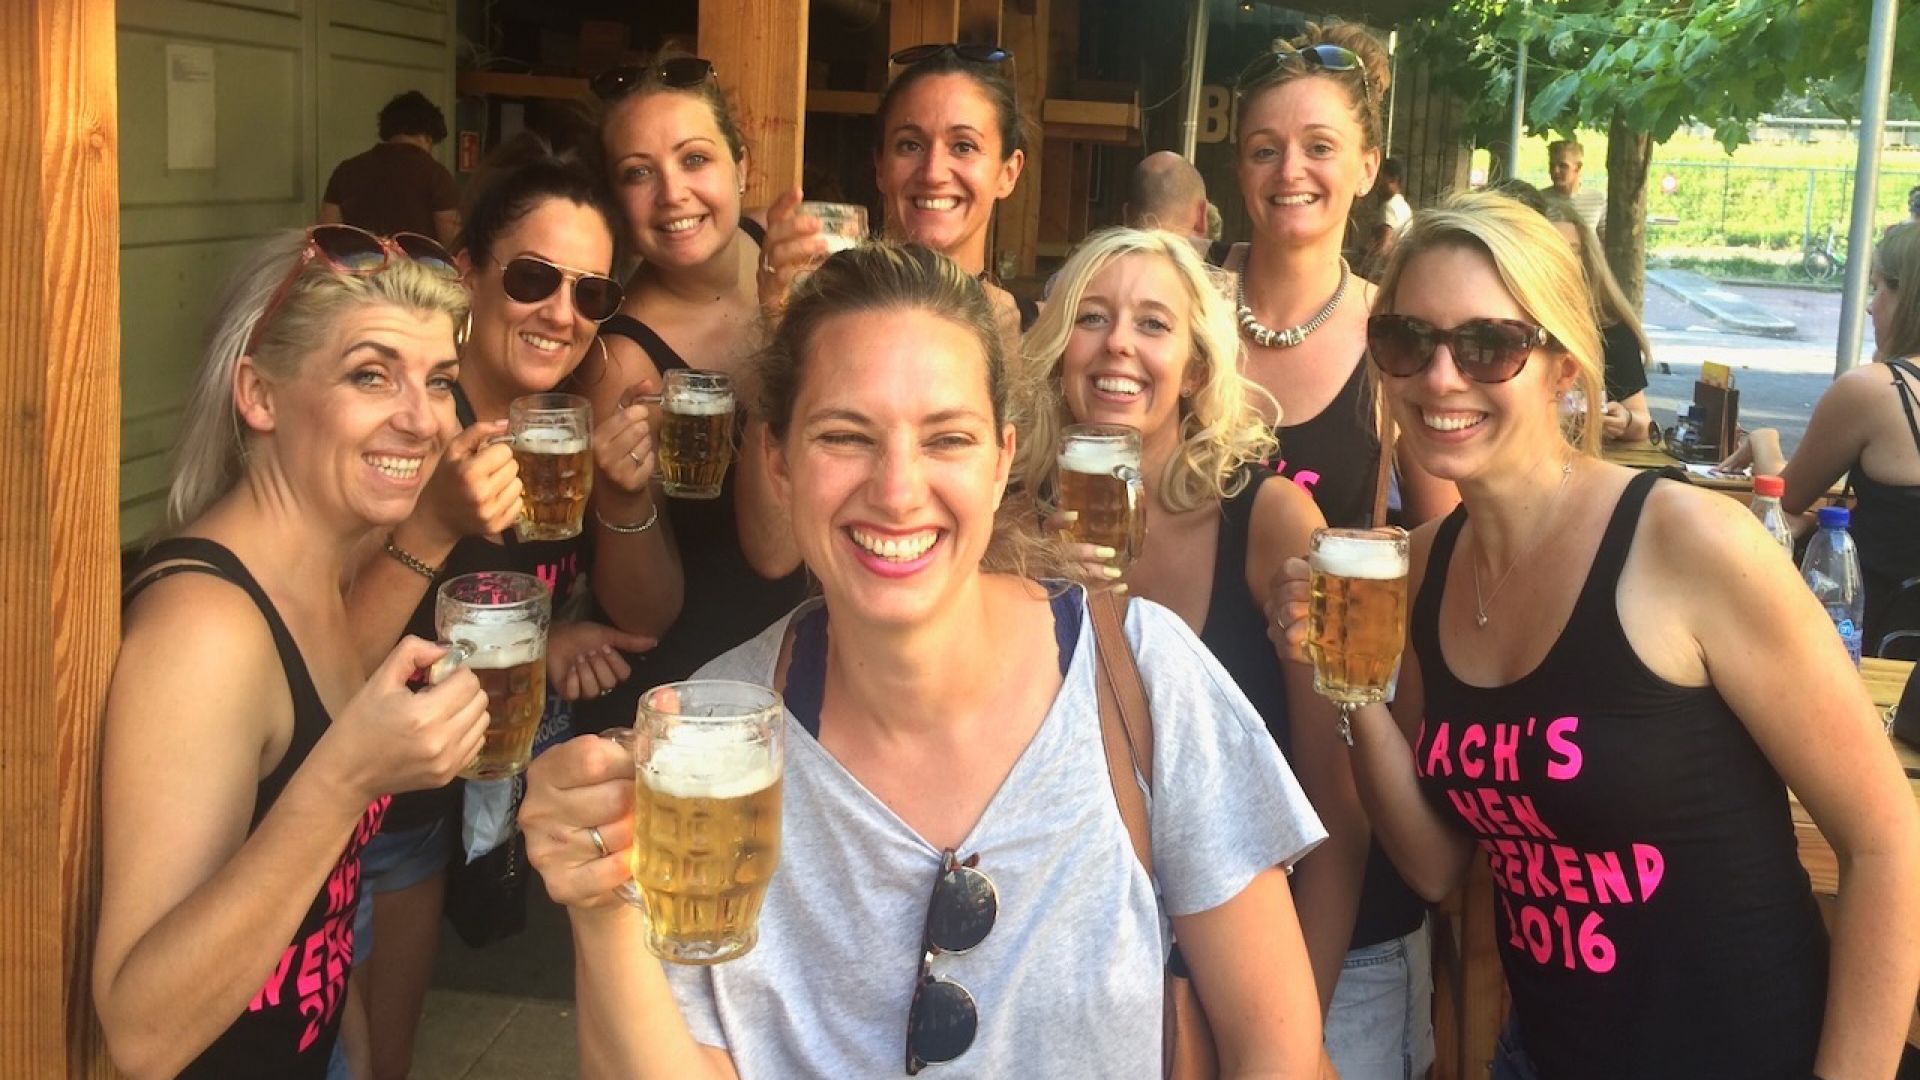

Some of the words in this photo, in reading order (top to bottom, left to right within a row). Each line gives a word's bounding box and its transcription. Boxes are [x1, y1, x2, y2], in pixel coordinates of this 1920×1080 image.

[1196, 84, 1238, 144] B
[1415, 717, 1584, 782] ACH'S
[1447, 788, 1558, 840] HEN
[1477, 838, 1666, 904] EEKEND
